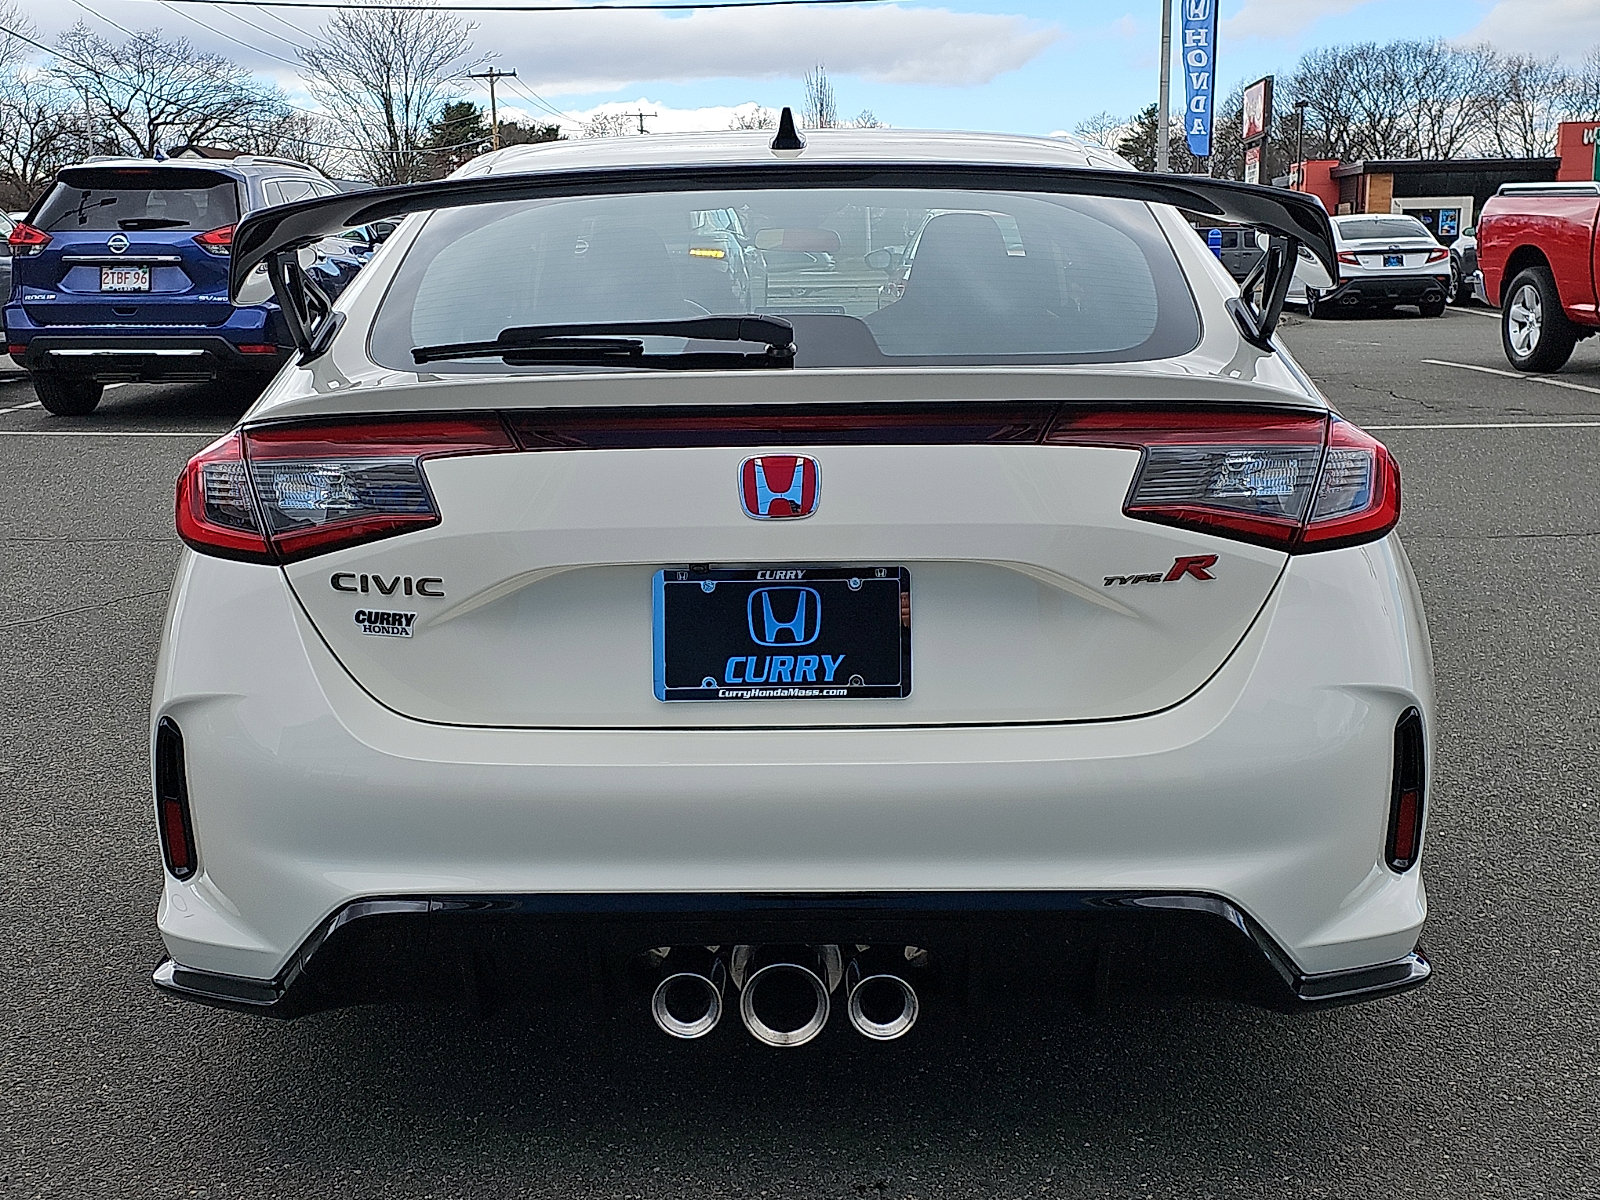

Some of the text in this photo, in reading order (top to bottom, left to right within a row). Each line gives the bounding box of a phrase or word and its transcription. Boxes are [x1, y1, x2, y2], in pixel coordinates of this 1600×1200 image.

[102, 271, 147, 285] 2TBF 96
[756, 569, 806, 580] CURRY
[1103, 553, 1219, 586] TYPE R
[330, 572, 445, 597] CIVIC
[354, 609, 416, 627] CURRY
[362, 624, 410, 636] HONDA
[724, 654, 846, 684] CURRY
[718, 688, 848, 699] CurryHondaMass.com
